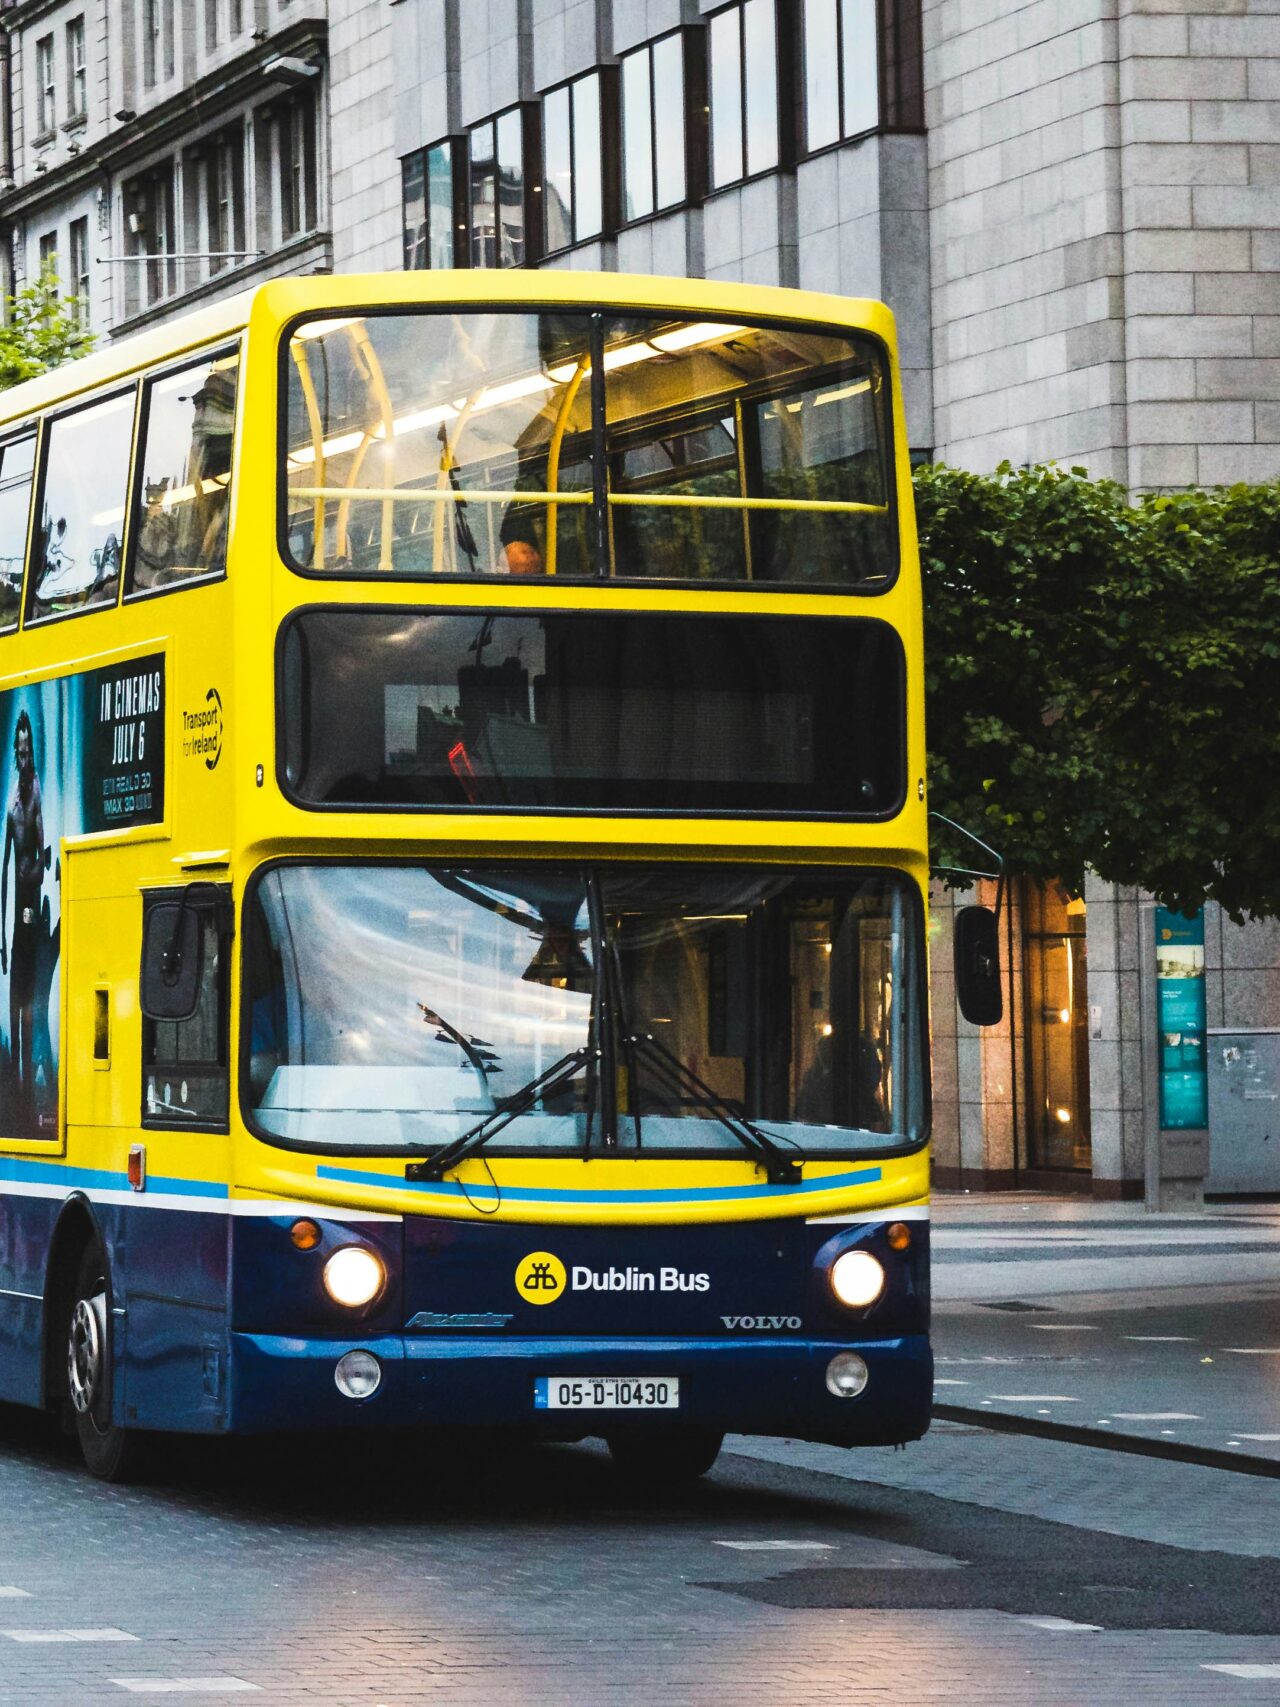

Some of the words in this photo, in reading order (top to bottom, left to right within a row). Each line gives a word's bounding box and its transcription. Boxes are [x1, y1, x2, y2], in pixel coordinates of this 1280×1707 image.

[101, 682, 112, 722] IN
[114, 671, 160, 720] CINEMAS
[183, 706, 218, 731] Transport
[112, 723, 136, 765] JULY
[138, 720, 146, 761] 6
[183, 737, 192, 757] for
[192, 732, 218, 756] Ireland
[571, 1266, 655, 1292] Dublin
[660, 1267, 710, 1292] Bus
[720, 1315, 802, 1329] VOLVO
[558, 1383, 669, 1406] 05-D-10430
